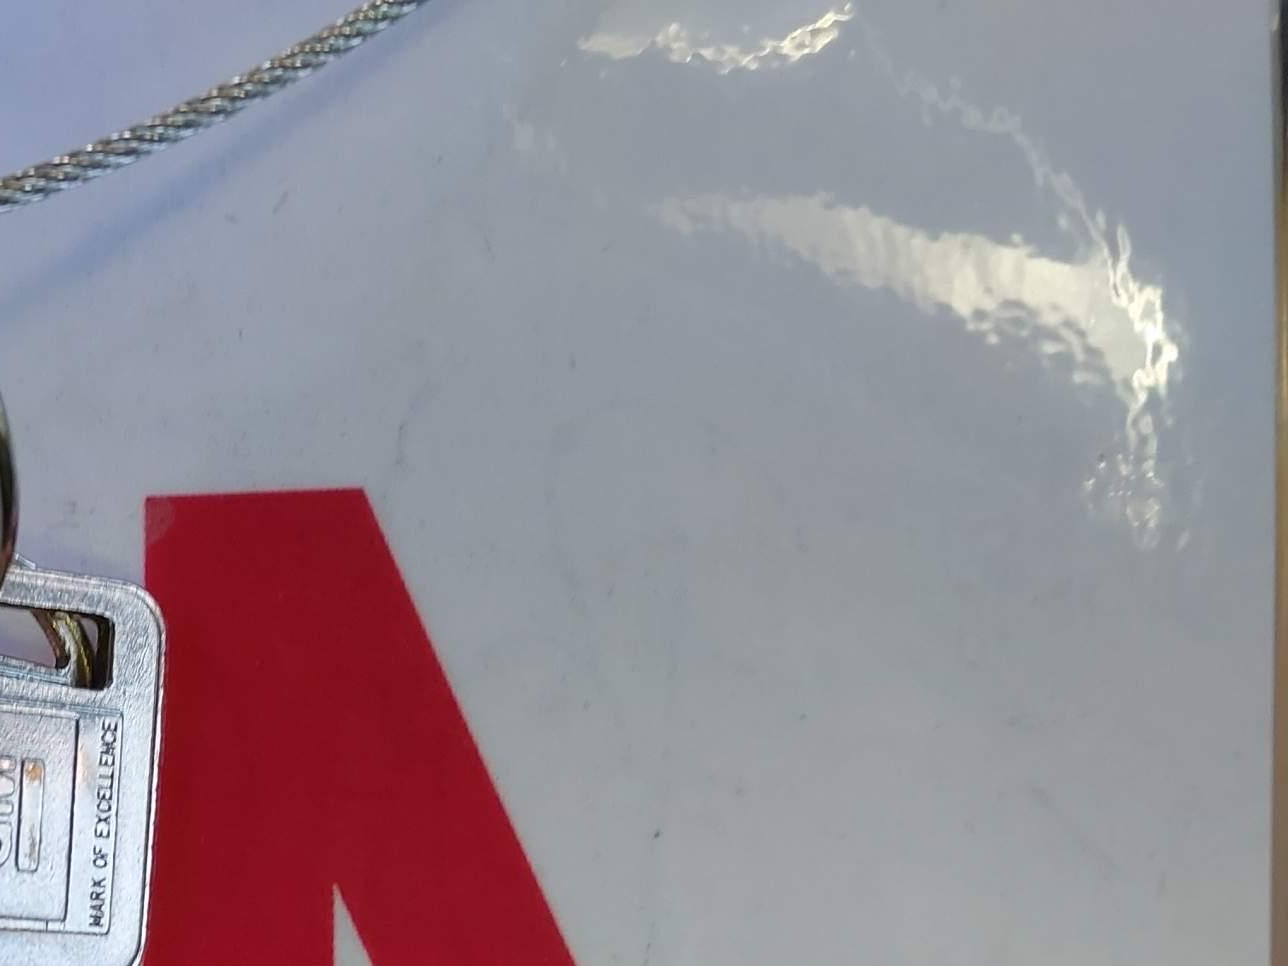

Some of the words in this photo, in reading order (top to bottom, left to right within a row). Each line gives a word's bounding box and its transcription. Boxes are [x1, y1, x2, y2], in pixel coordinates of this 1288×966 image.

[94, 718, 119, 839] EXCELLENCE
[93, 844, 109, 869] OF
[89, 877, 107, 928] MARK
